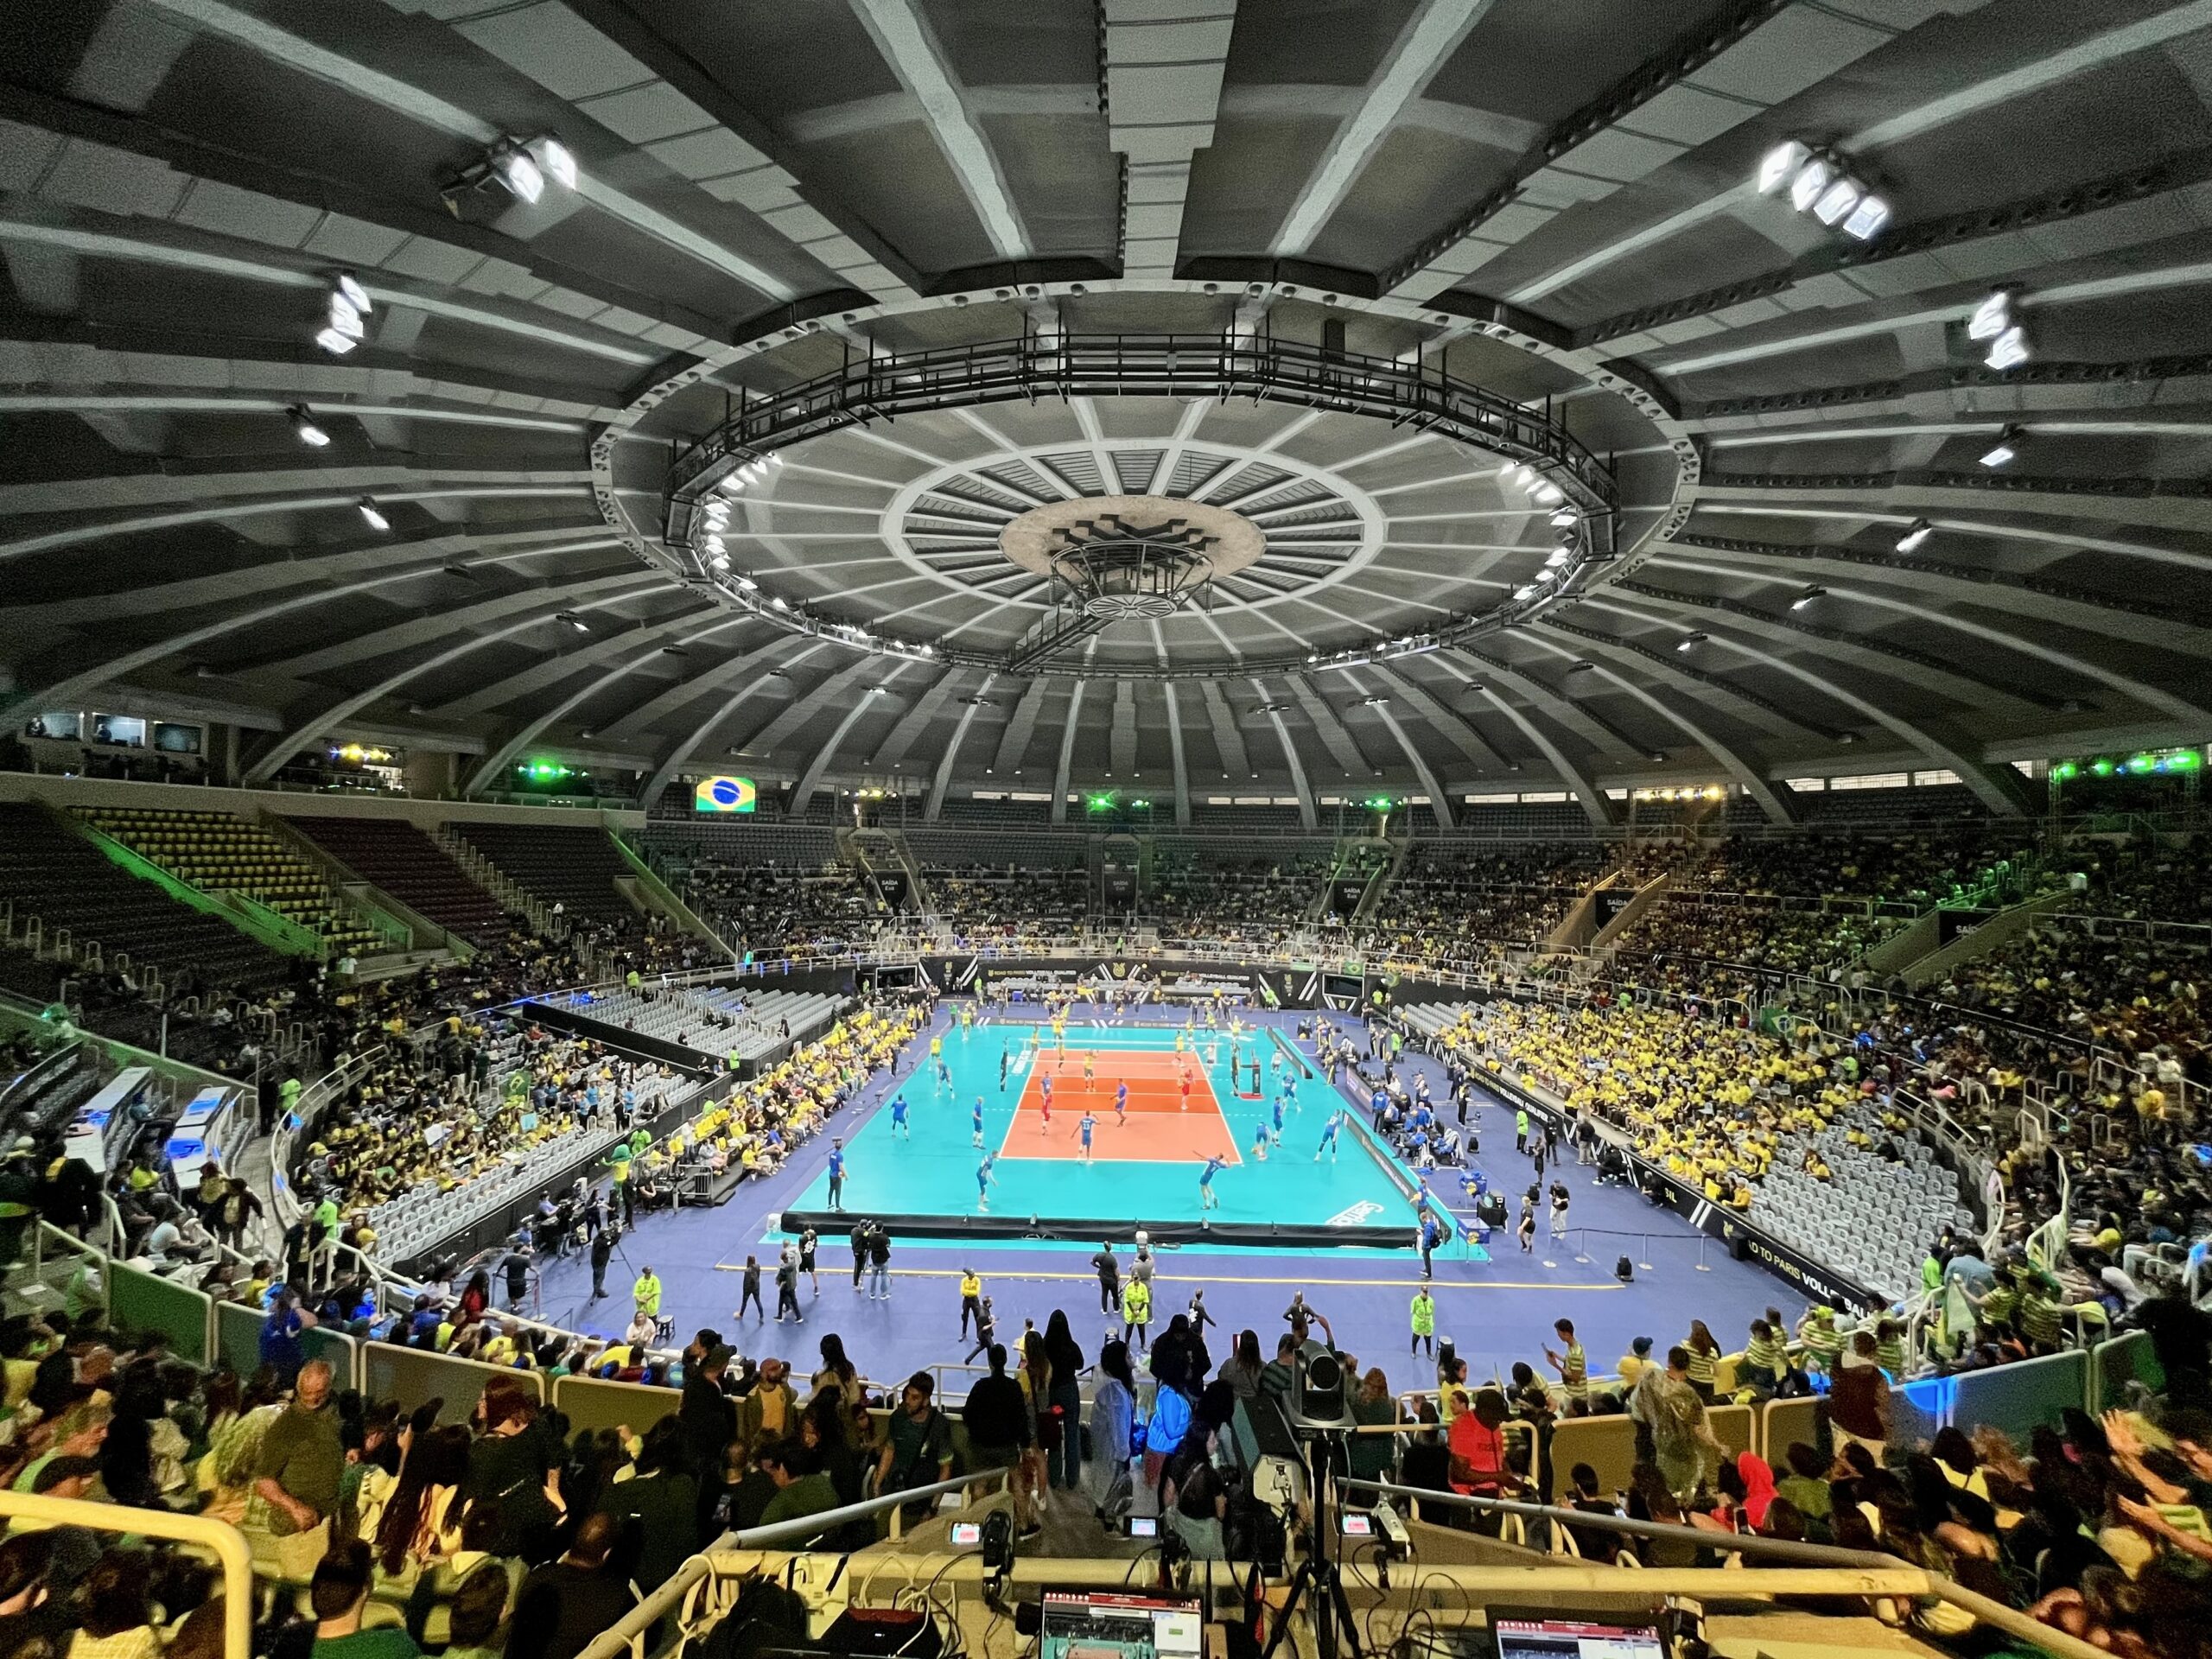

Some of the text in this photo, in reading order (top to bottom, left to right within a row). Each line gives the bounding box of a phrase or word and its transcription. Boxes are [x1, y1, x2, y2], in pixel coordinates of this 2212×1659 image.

[1955, 924, 1979, 933] SAÍD
[1664, 1187, 1677, 1203] SIL
[1759, 1246, 1772, 1262] TO
[1773, 1255, 1801, 1280] PARIS
